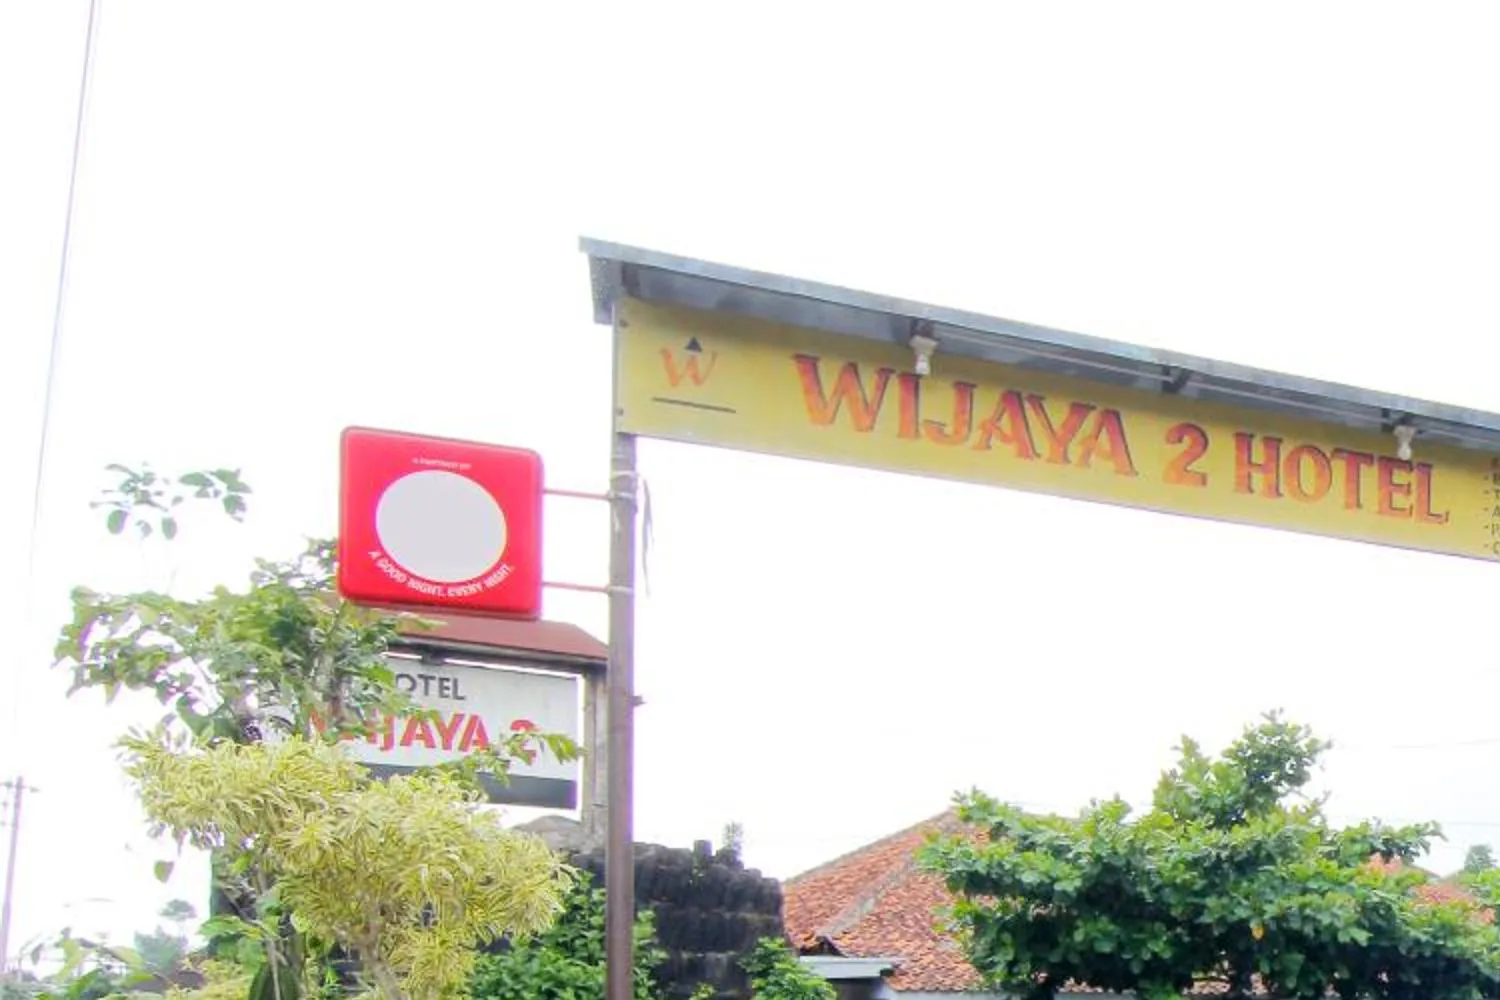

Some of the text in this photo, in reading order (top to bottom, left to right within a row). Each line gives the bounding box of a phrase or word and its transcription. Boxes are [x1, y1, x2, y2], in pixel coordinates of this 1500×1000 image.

[660, 348, 718, 388] W
[792, 352, 1450, 526] WIJAYA 2 HOTEL
[376, 558, 408, 585] GOOD
[395, 672, 467, 700] OTEL
